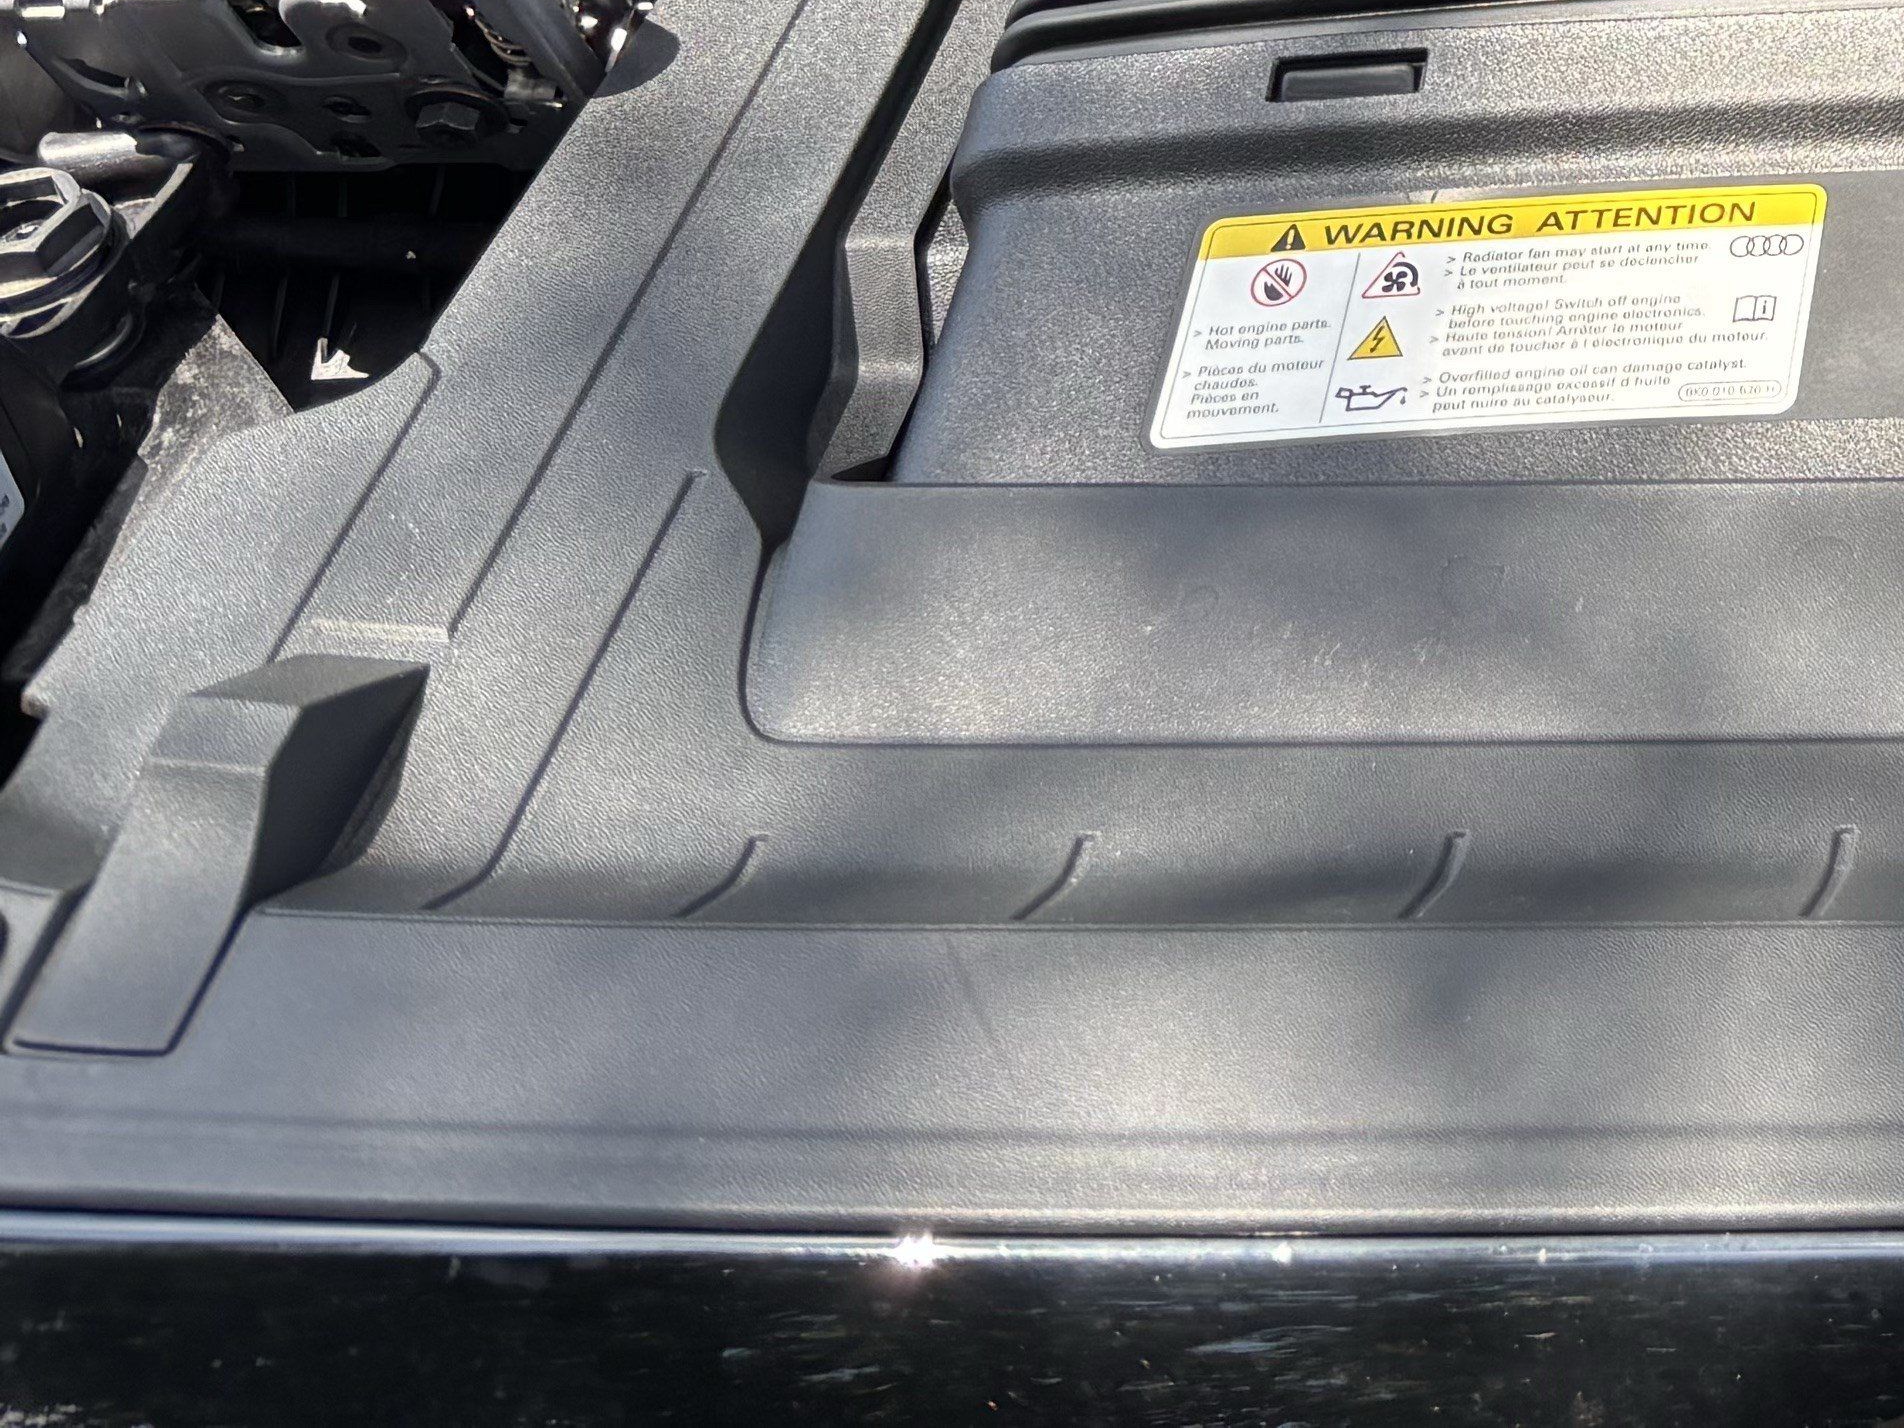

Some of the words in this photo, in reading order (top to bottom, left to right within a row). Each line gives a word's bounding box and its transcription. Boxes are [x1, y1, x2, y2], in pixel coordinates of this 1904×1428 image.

[1325, 214, 1513, 245] WARNING
[1536, 202, 1755, 233] ATTENTION
[1463, 251, 1522, 262] Radiator
[1529, 248, 1550, 258] fan
[1555, 248, 1585, 260] may
[1646, 244, 1671, 258] any
[1460, 266, 1476, 276] Le
[1482, 261, 1558, 275] ventilateur
[1562, 261, 1594, 275] peut
[1600, 260, 1615, 268] se
[1470, 279, 1498, 289] tout
[1451, 304, 1484, 321] High
[1555, 298, 1602, 309] Switch
[1608, 296, 1627, 306] off
[1632, 295, 1680, 311] engine
[1209, 326, 1233, 336] Hot
[1238, 322, 1287, 337] engine
[1449, 315, 1494, 329] before
[1501, 312, 1565, 329] touching
[1569, 312, 1618, 328] engine
[1446, 332, 1487, 342] Haute
[1612, 323, 1625, 334] le
[1630, 321, 1682, 333] moteur
[1205, 334, 1259, 350] Moving
[1442, 346, 1482, 356] avant
[1488, 343, 1504, 354] de
[1511, 341, 1564, 352] toucher
[1689, 333, 1706, 344] du
[1248, 362, 1266, 374] du
[1439, 370, 1510, 383] Overfilled
[1516, 369, 1565, 385] engine
[1570, 366, 1587, 376] oil
[1593, 366, 1617, 374] can
[1623, 363, 1682, 377] damage
[1437, 386, 1456, 397] Un
[1557, 377, 1615, 390] excessif
[1433, 400, 1465, 413] peut
[1471, 395, 1507, 408] nuire
[1513, 398, 1530, 406] au
